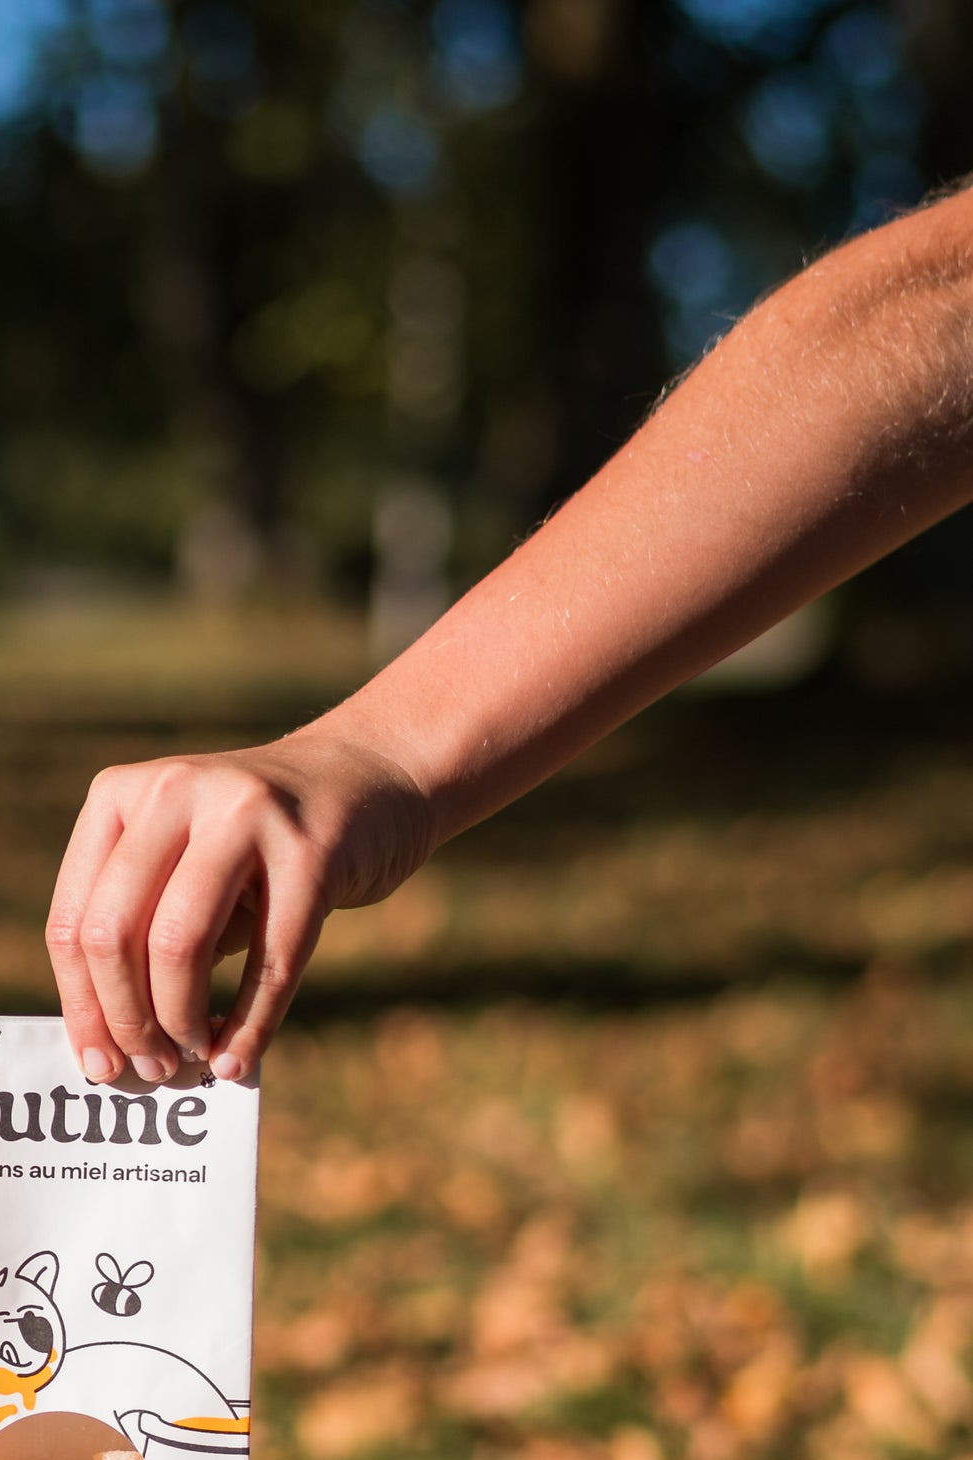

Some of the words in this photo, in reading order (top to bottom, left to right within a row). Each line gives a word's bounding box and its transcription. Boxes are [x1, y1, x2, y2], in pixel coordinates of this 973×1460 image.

[29, 1163, 56, 1179] au
[61, 1161, 107, 1181] miel
[113, 1165, 207, 1183] artisanal
